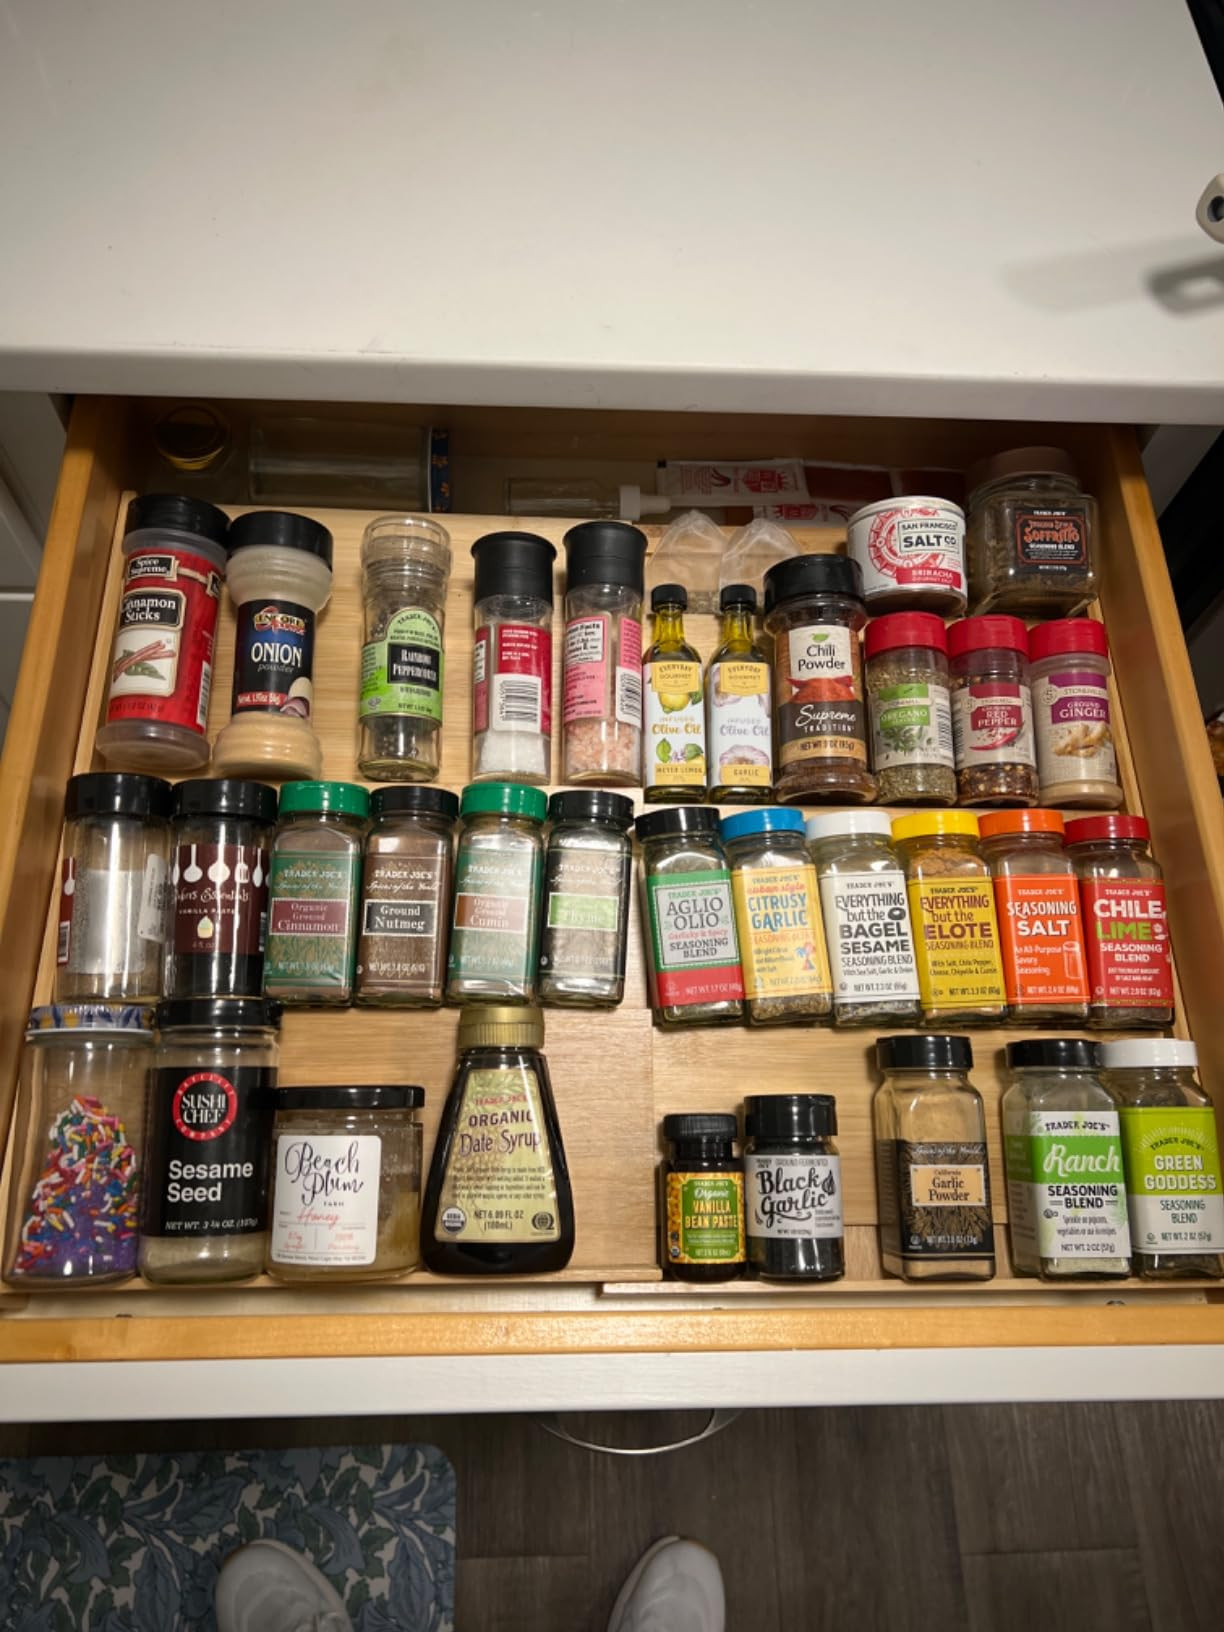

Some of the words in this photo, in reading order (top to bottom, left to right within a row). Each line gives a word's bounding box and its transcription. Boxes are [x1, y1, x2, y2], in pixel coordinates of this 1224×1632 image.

[903, 535, 942, 548] SALT
[944, 536, 956, 545] CO
[125, 610, 161, 623] Sticks
[251, 642, 302, 667] ONION
[806, 644, 836, 658] Chili
[798, 657, 846, 672] Powder
[795, 704, 856, 727] Supreme
[986, 711, 1008, 719] RED
[1059, 708, 1106, 719] GINGER
[978, 717, 1017, 728] PEPPER
[733, 768, 760, 777] GARLIC
[930, 887, 956, 895] TRADER
[666, 896, 724, 916] AGLIO
[747, 893, 808, 913] CITRUSY
[834, 892, 905, 911] EVERYTHING
[920, 895, 990, 912] EVERYTHING
[1093, 899, 1162, 919] CHILE
[380, 905, 421, 917] Ground
[847, 908, 867, 922] but
[868, 908, 886, 921] the
[932, 910, 952, 923] but
[954, 910, 974, 922] the
[1007, 901, 1077, 919] SEASONING
[278, 919, 339, 932] Cinnamon
[374, 916, 425, 931] Nutmeg
[673, 911, 720, 931] OLIO
[752, 910, 809, 932] GARLIC
[1017, 920, 1070, 937] SALT
[840, 922, 908, 940] BAGEL
[924, 921, 993, 940] ELOTE
[1096, 922, 1152, 940] LIME
[670, 938, 729, 952] SEASONING
[840, 939, 911, 955] SESAME
[1100, 942, 1163, 953] SEASONING
[683, 947, 718, 959] BLEND
[841, 956, 887, 967] SEASONING
[888, 954, 913, 966] BLEND
[1114, 954, 1150, 963] BLEND
[182, 1094, 226, 1109] SUSHI
[183, 1109, 223, 1124] CHEF
[468, 1109, 534, 1128] ORGANIC
[1045, 1120, 1080, 1131] TRADER
[459, 1132, 495, 1158] Date
[498, 1129, 541, 1154] Syrup
[1151, 1136, 1179, 1151] TRADER
[285, 1140, 360, 1183] Beach
[1043, 1143, 1121, 1178] Ranch
[1154, 1155, 1204, 1171] GREEN
[169, 1160, 254, 1179] Sesame
[301, 1170, 364, 1207] Plum
[755, 1167, 820, 1195] Black
[932, 1175, 966, 1189] Garlic
[1144, 1174, 1217, 1191] GODDESS
[167, 1182, 223, 1202] Seed
[928, 1188, 970, 1202] Powder
[1047, 1185, 1118, 1197] SEASONING
[693, 1200, 732, 1214] VANILLA
[760, 1188, 829, 1229] Garlic
[1064, 1197, 1105, 1209] BLEND
[1160, 1200, 1206, 1211] SEASONING
[474, 1210, 487, 1219] NET
[685, 1215, 710, 1228] BEAN
[712, 1214, 738, 1228] PASTE
[1171, 1212, 1199, 1224] BLEND
[165, 1220, 183, 1230] NET
